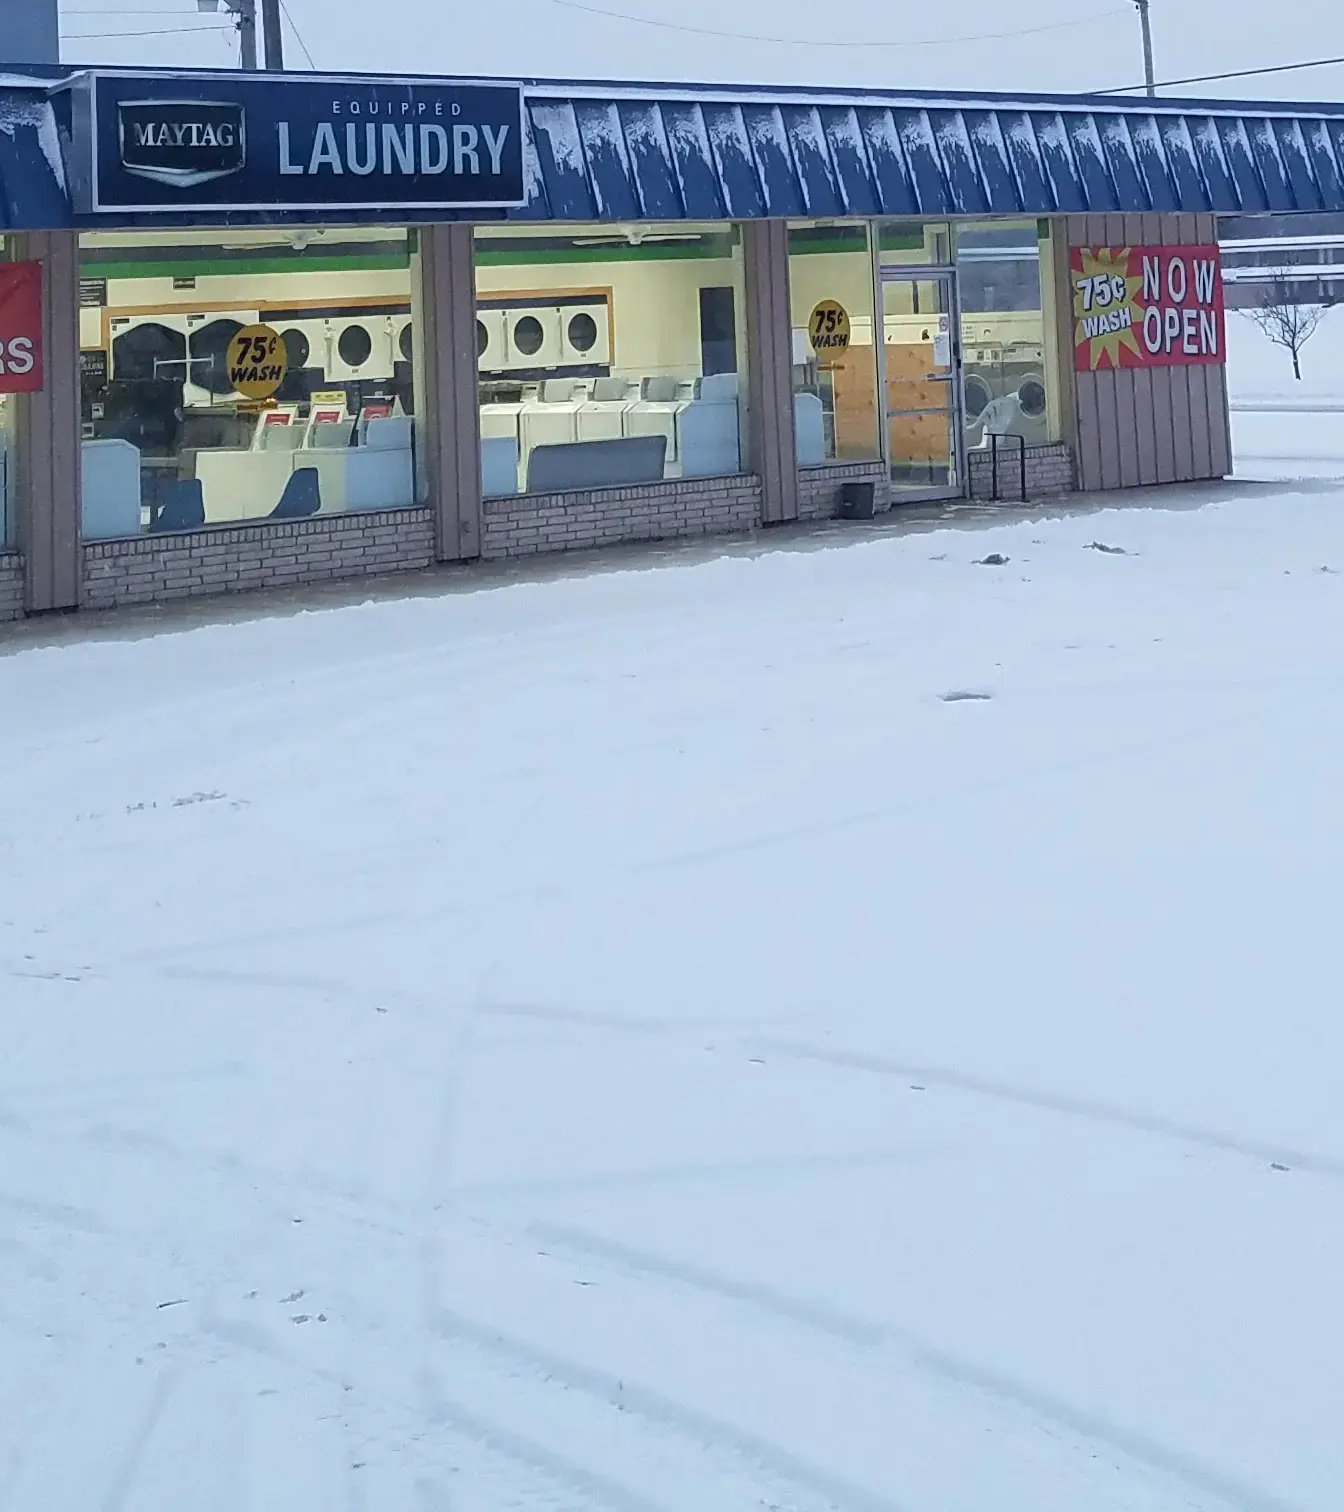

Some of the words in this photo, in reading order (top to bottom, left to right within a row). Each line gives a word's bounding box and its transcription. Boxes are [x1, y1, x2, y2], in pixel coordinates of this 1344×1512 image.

[332, 100, 462, 116] EQUIPPED
[132, 121, 235, 148] MAYTAG
[277, 121, 510, 176] LAUNDRY
[1076, 273, 1127, 311] 75¢
[1142, 255, 1217, 304] NOW
[1081, 307, 1133, 339] WASH
[1143, 305, 1219, 356] OPEN
[236, 336, 277, 365] 75¢
[810, 333, 848, 349] WASH
[230, 365, 282, 383] WASH
